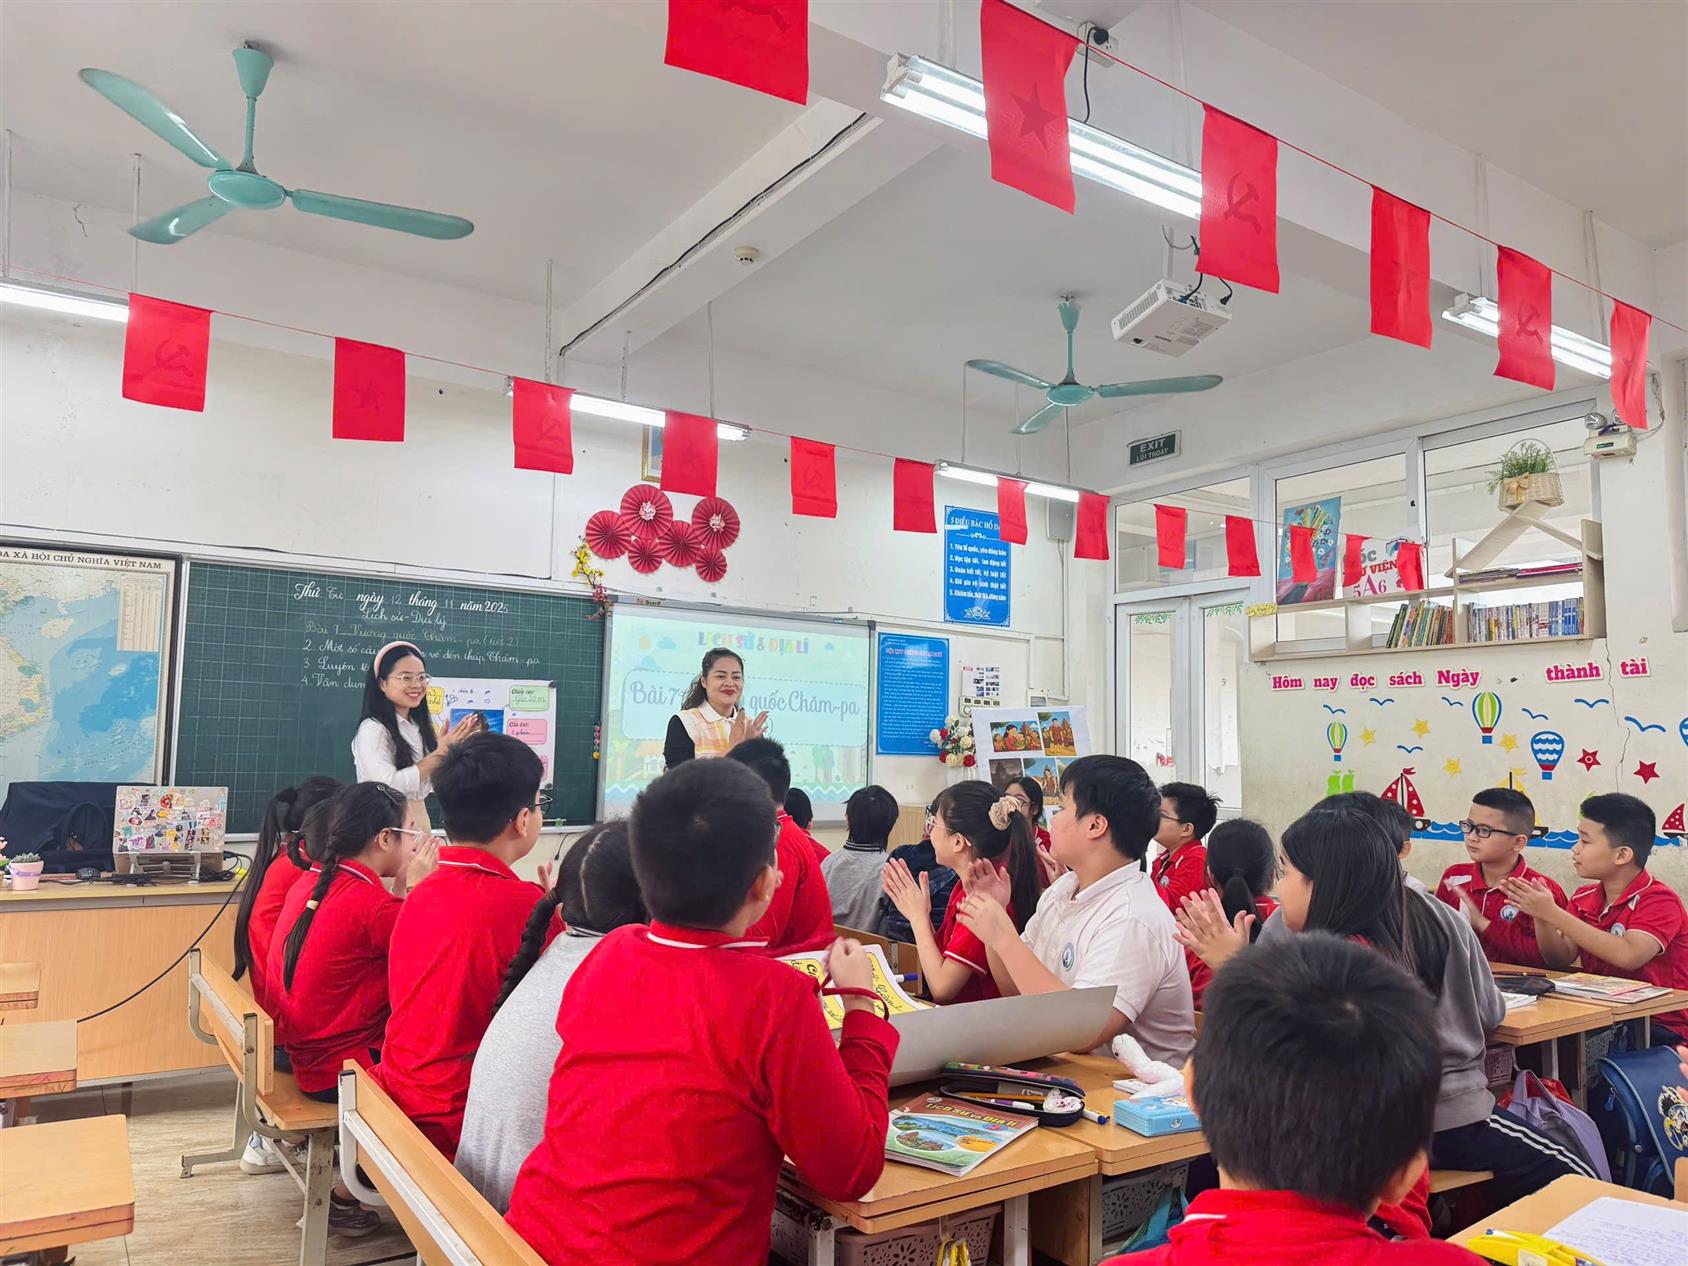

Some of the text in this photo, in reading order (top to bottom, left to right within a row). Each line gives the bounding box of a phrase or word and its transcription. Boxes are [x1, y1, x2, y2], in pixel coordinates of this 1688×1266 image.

[1140, 438, 1166, 453] EXIT
[13, 551, 29, 559] XÃ
[32, 553, 50, 562] HỘI
[53, 552, 74, 563] CHỦ
[78, 556, 110, 565] NGHĨA
[113, 558, 137, 569] VIỆT
[139, 561, 162, 569] NAM
[1353, 575, 1387, 597] 5A6
[294, 581, 321, 600] Thứ
[356, 592, 384, 612] ngày
[391, 594, 402, 606] 12
[408, 591, 439, 616] tháng
[445, 599, 454, 609] 11
[460, 600, 483, 611] năm
[484, 600, 509, 614] 2025
[756, 636, 766, 651] &
[1272, 658, 1648, 691] Hôm nay đọc sách Ngày thành tài
[630, 680, 667, 705] Bài
[749, 688, 787, 714] quốc
[788, 690, 861, 721] Chăm-pa
[924, 1103, 952, 1112] Lịch
